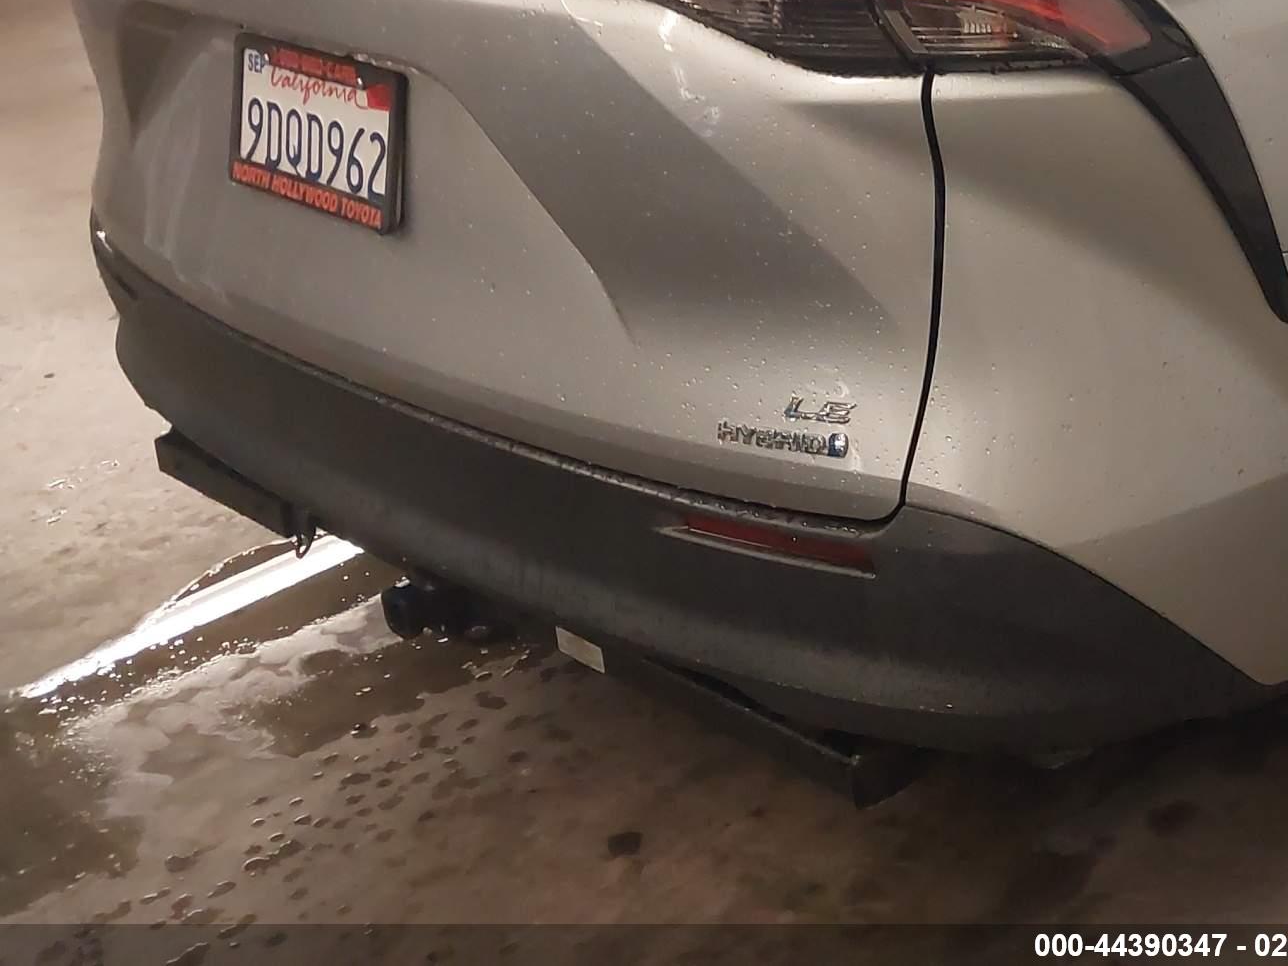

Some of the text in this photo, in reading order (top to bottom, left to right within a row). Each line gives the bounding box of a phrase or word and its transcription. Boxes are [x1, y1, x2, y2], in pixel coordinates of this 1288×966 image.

[247, 97, 386, 202] 9DQD962
[232, 161, 383, 230] NORTH HOLLYWOOD TOYOTA
[783, 396, 857, 425] LE
[717, 421, 827, 457] HYBRID
